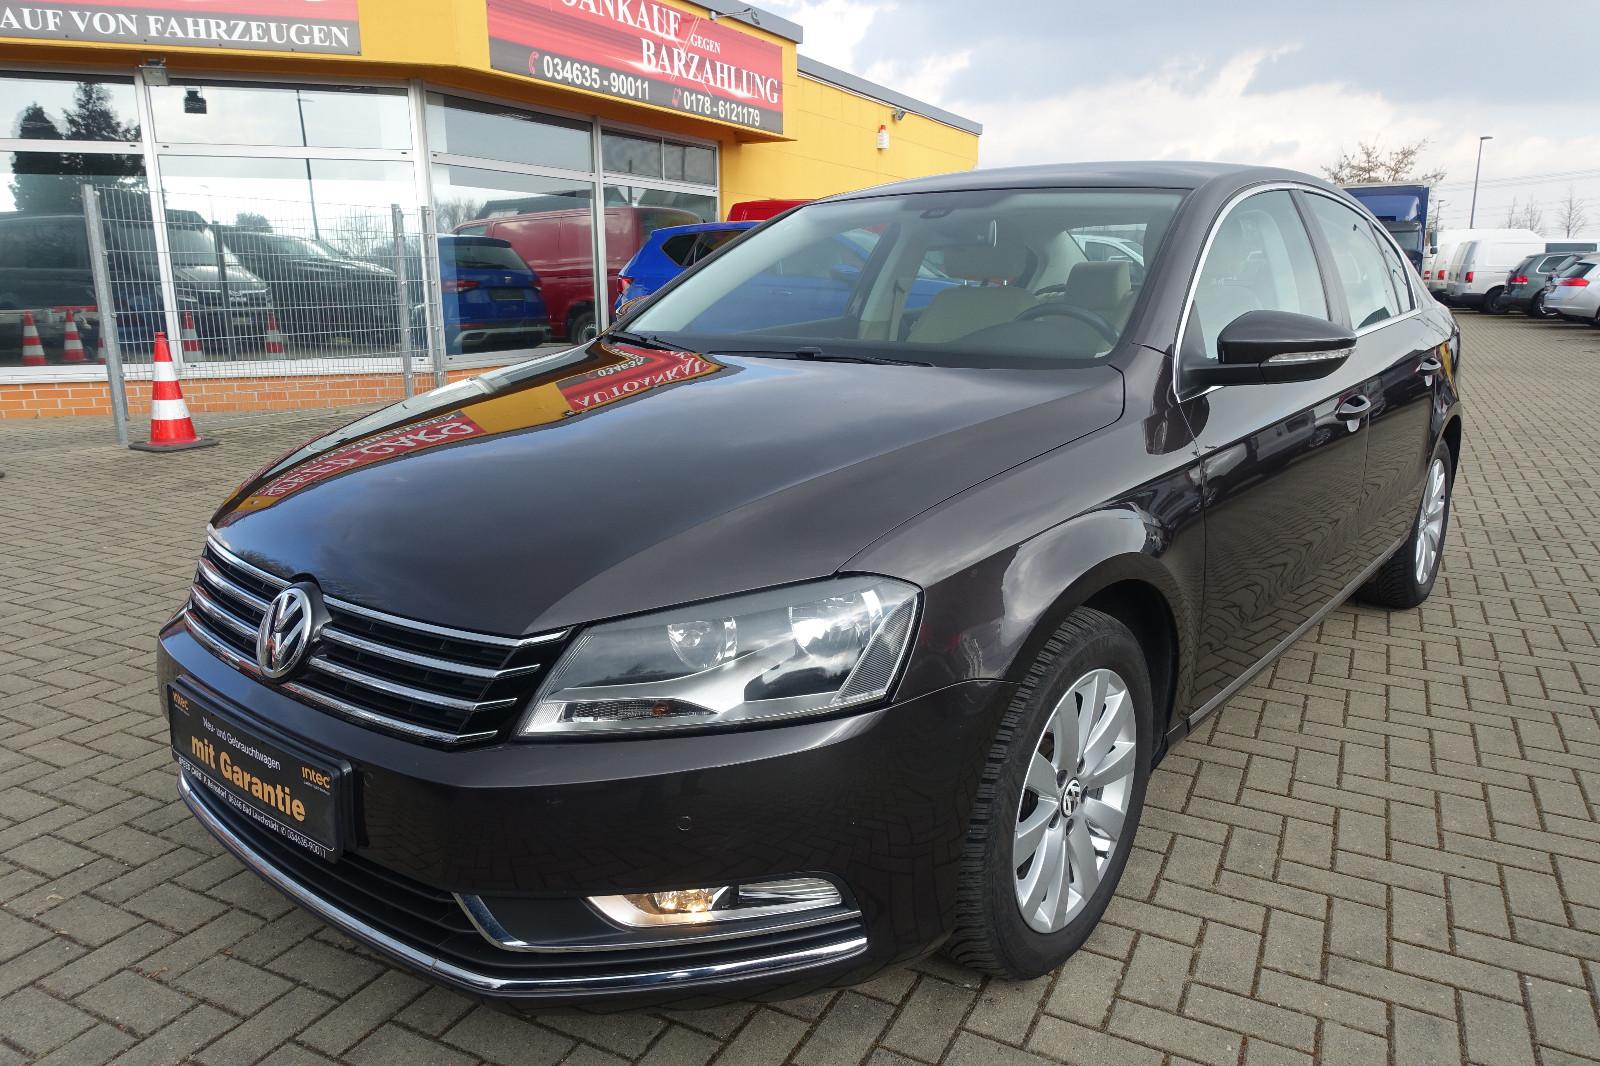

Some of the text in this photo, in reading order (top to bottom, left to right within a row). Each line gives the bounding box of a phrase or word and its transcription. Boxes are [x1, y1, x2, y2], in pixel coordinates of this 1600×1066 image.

[69, 10, 138, 35] VON
[146, 15, 349, 47] FAHRZEUGEN
[559, 0, 681, 40] ANKAUF
[690, 34, 721, 55] GEGEN
[640, 37, 779, 104] BARZAHLUNG
[227, 733, 281, 771] Gebrauchtwagen
[191, 735, 306, 822] mit Garantie
